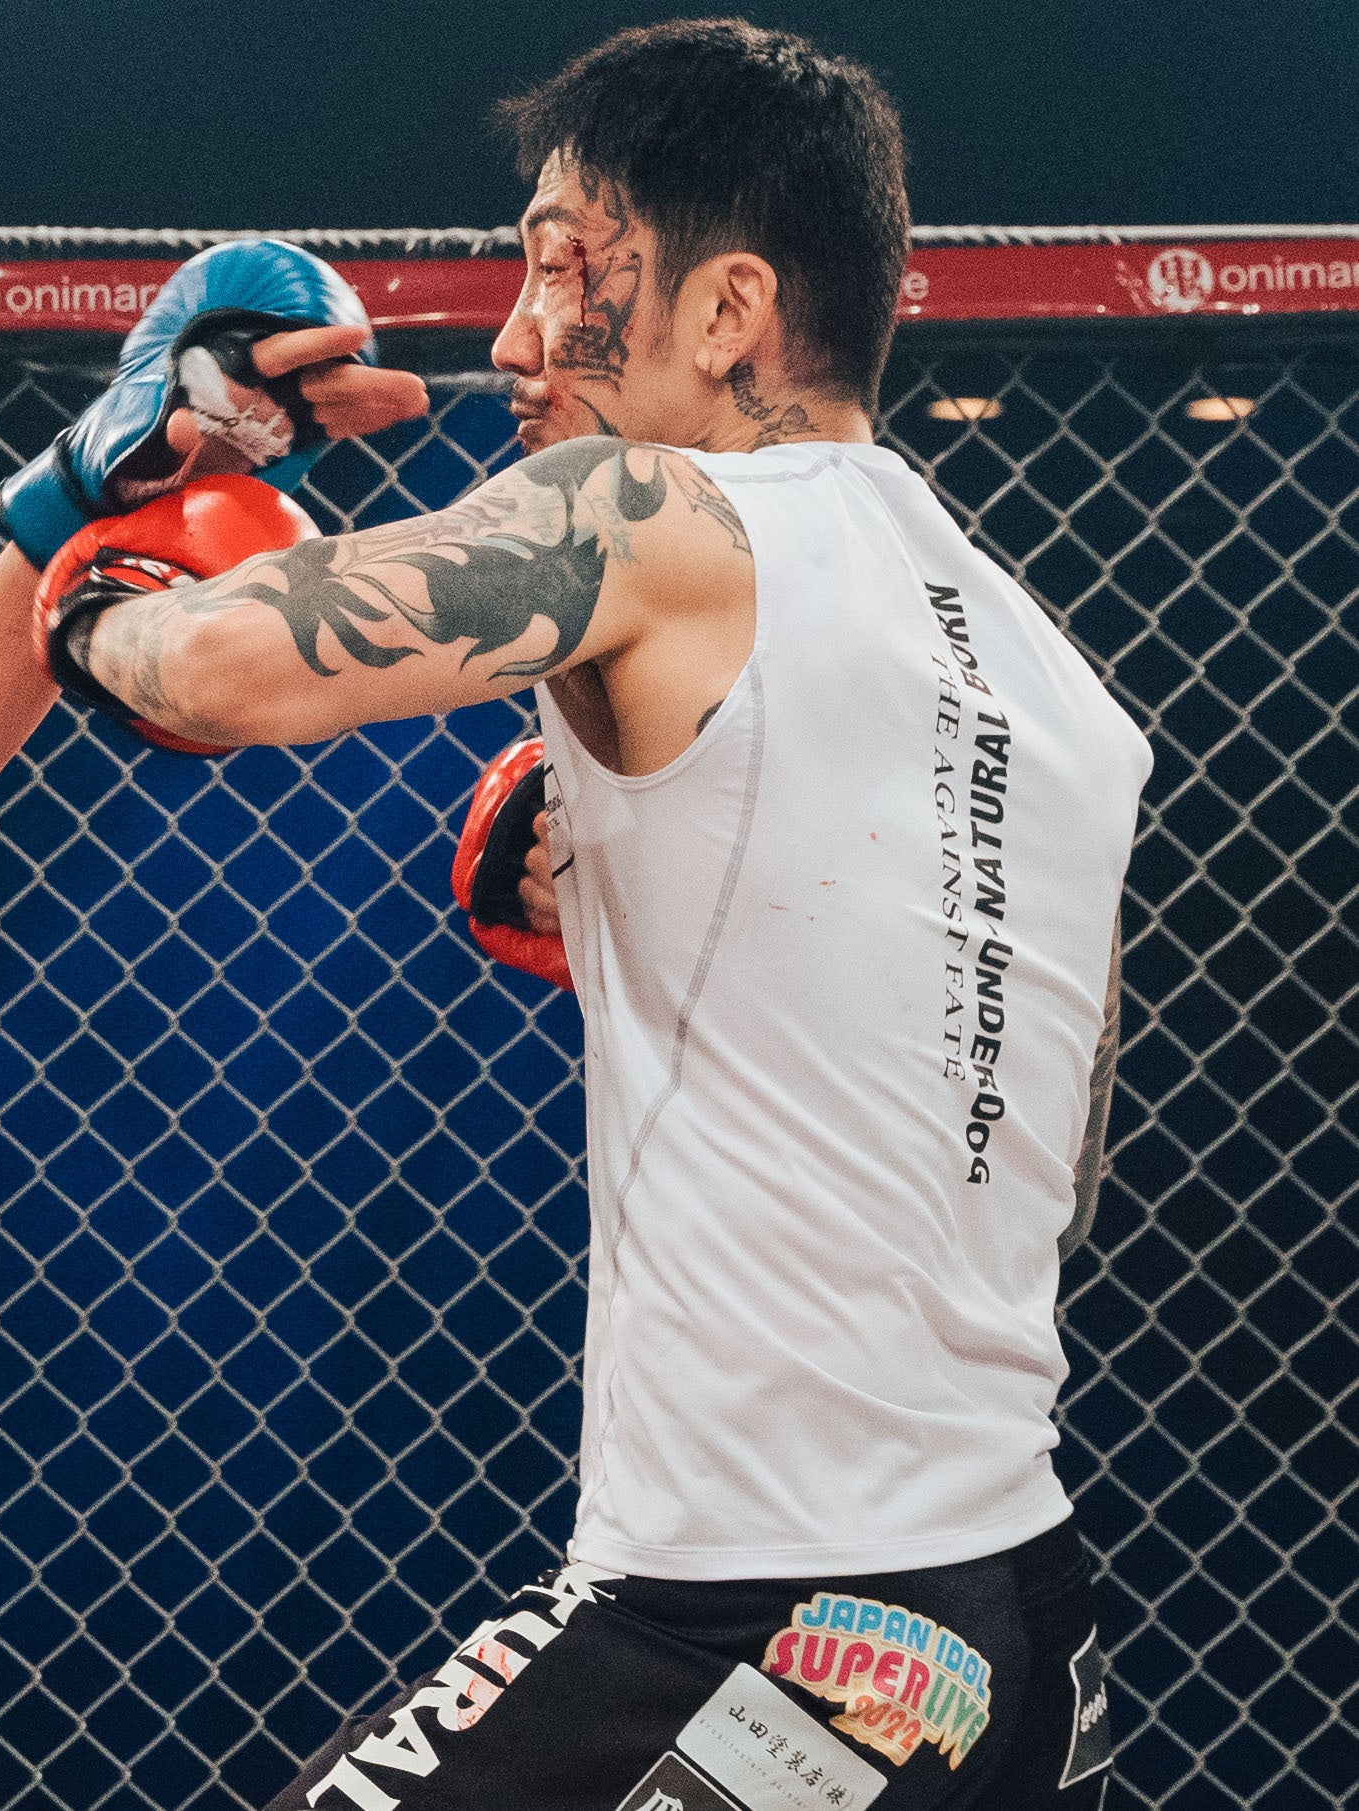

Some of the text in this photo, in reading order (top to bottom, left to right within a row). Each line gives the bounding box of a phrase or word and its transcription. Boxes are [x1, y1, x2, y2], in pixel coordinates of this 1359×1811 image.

[5, 275, 160, 314] onimar
[924, 580, 1012, 921] NATURAL BORN
[930, 651, 969, 1082] THE AGAINST FATE
[769, 1631, 930, 1713] SUPER
[924, 1673, 986, 1754] LIVE
[801, 1598, 987, 1700] JAPAN IDOL
[854, 1695, 923, 1751] 2022
